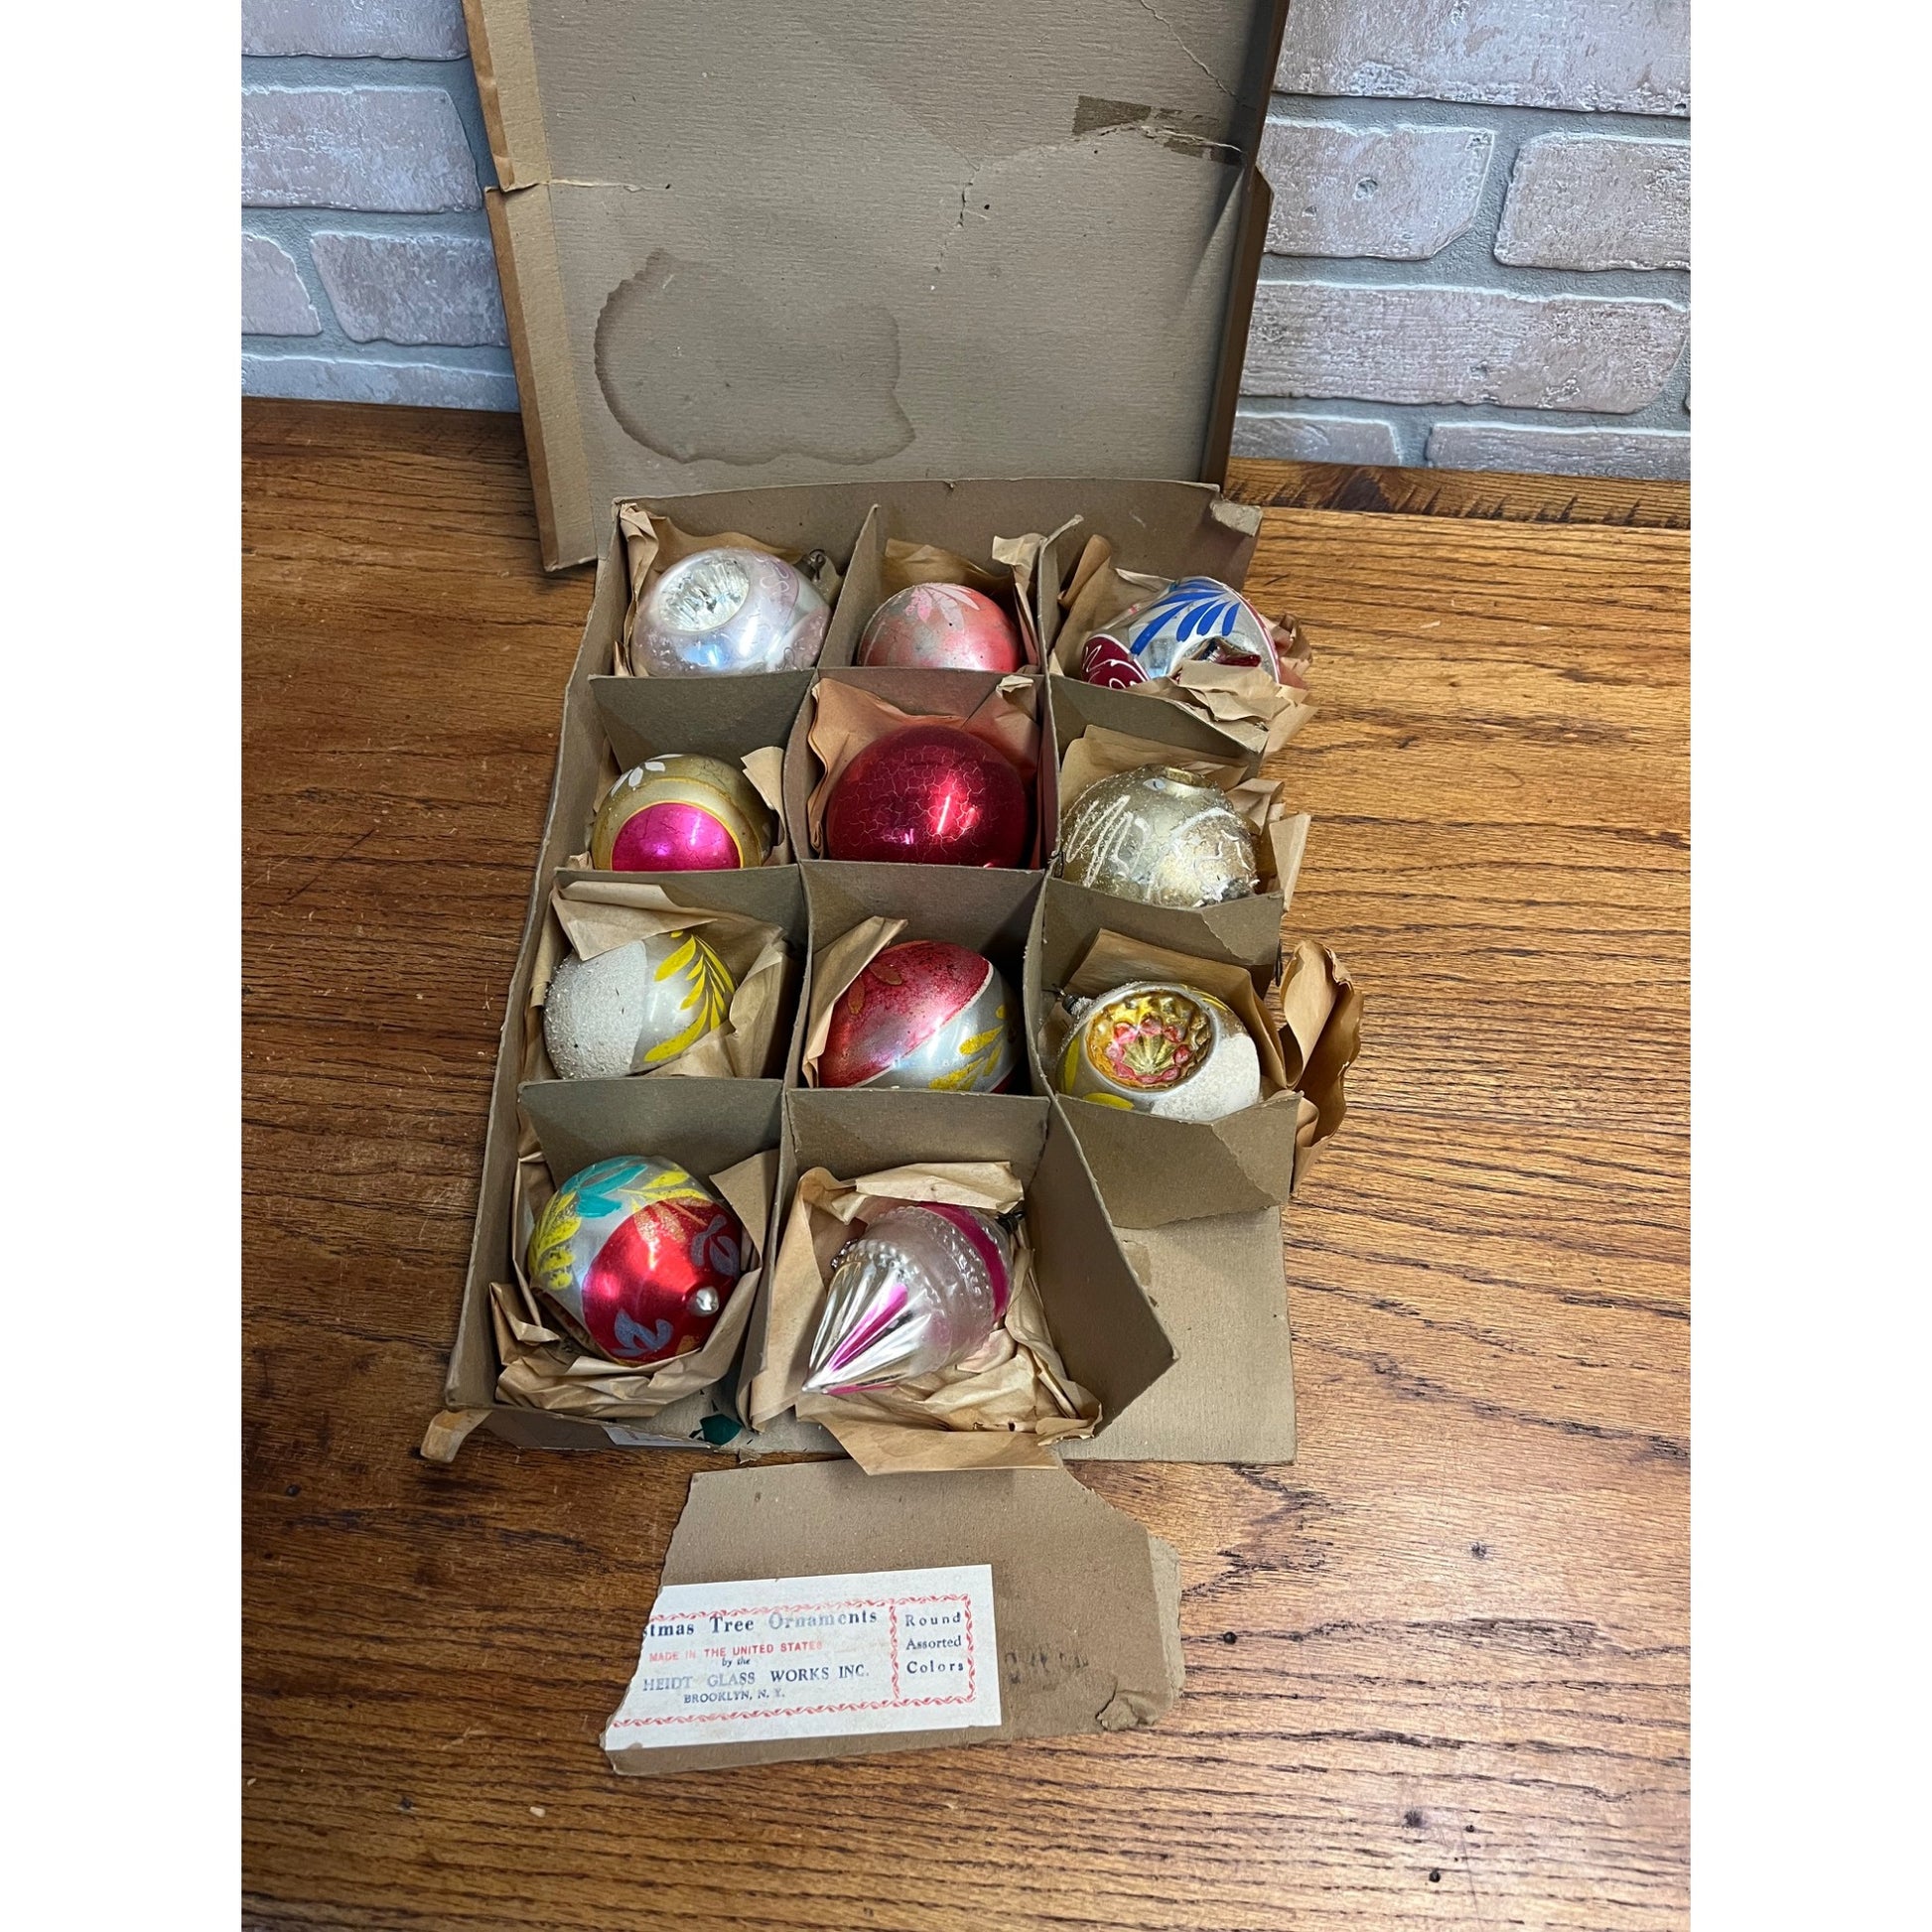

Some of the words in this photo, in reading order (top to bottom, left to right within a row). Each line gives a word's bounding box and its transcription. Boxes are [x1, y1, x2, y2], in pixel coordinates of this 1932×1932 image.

[710, 1616, 755, 1634] Tree
[768, 1610, 878, 1630] Ornaments
[904, 1612, 961, 1627] Round
[905, 1636, 962, 1650] Assorted
[649, 1651, 679, 1663] MADE
[685, 1650, 696, 1659] IN
[704, 1647, 727, 1658] THE
[733, 1644, 774, 1656] UNITED
[780, 1641, 823, 1653] STATES
[722, 1657, 733, 1667] by
[737, 1657, 751, 1666] the
[906, 1660, 964, 1674] Colors
[707, 1672, 756, 1687] GLASS
[770, 1667, 830, 1683] WORKS
[838, 1664, 870, 1679] INC.
[683, 1690, 754, 1704] BROOKLYN,
[758, 1689, 770, 1699] N.
[774, 1688, 785, 1698] Y.
